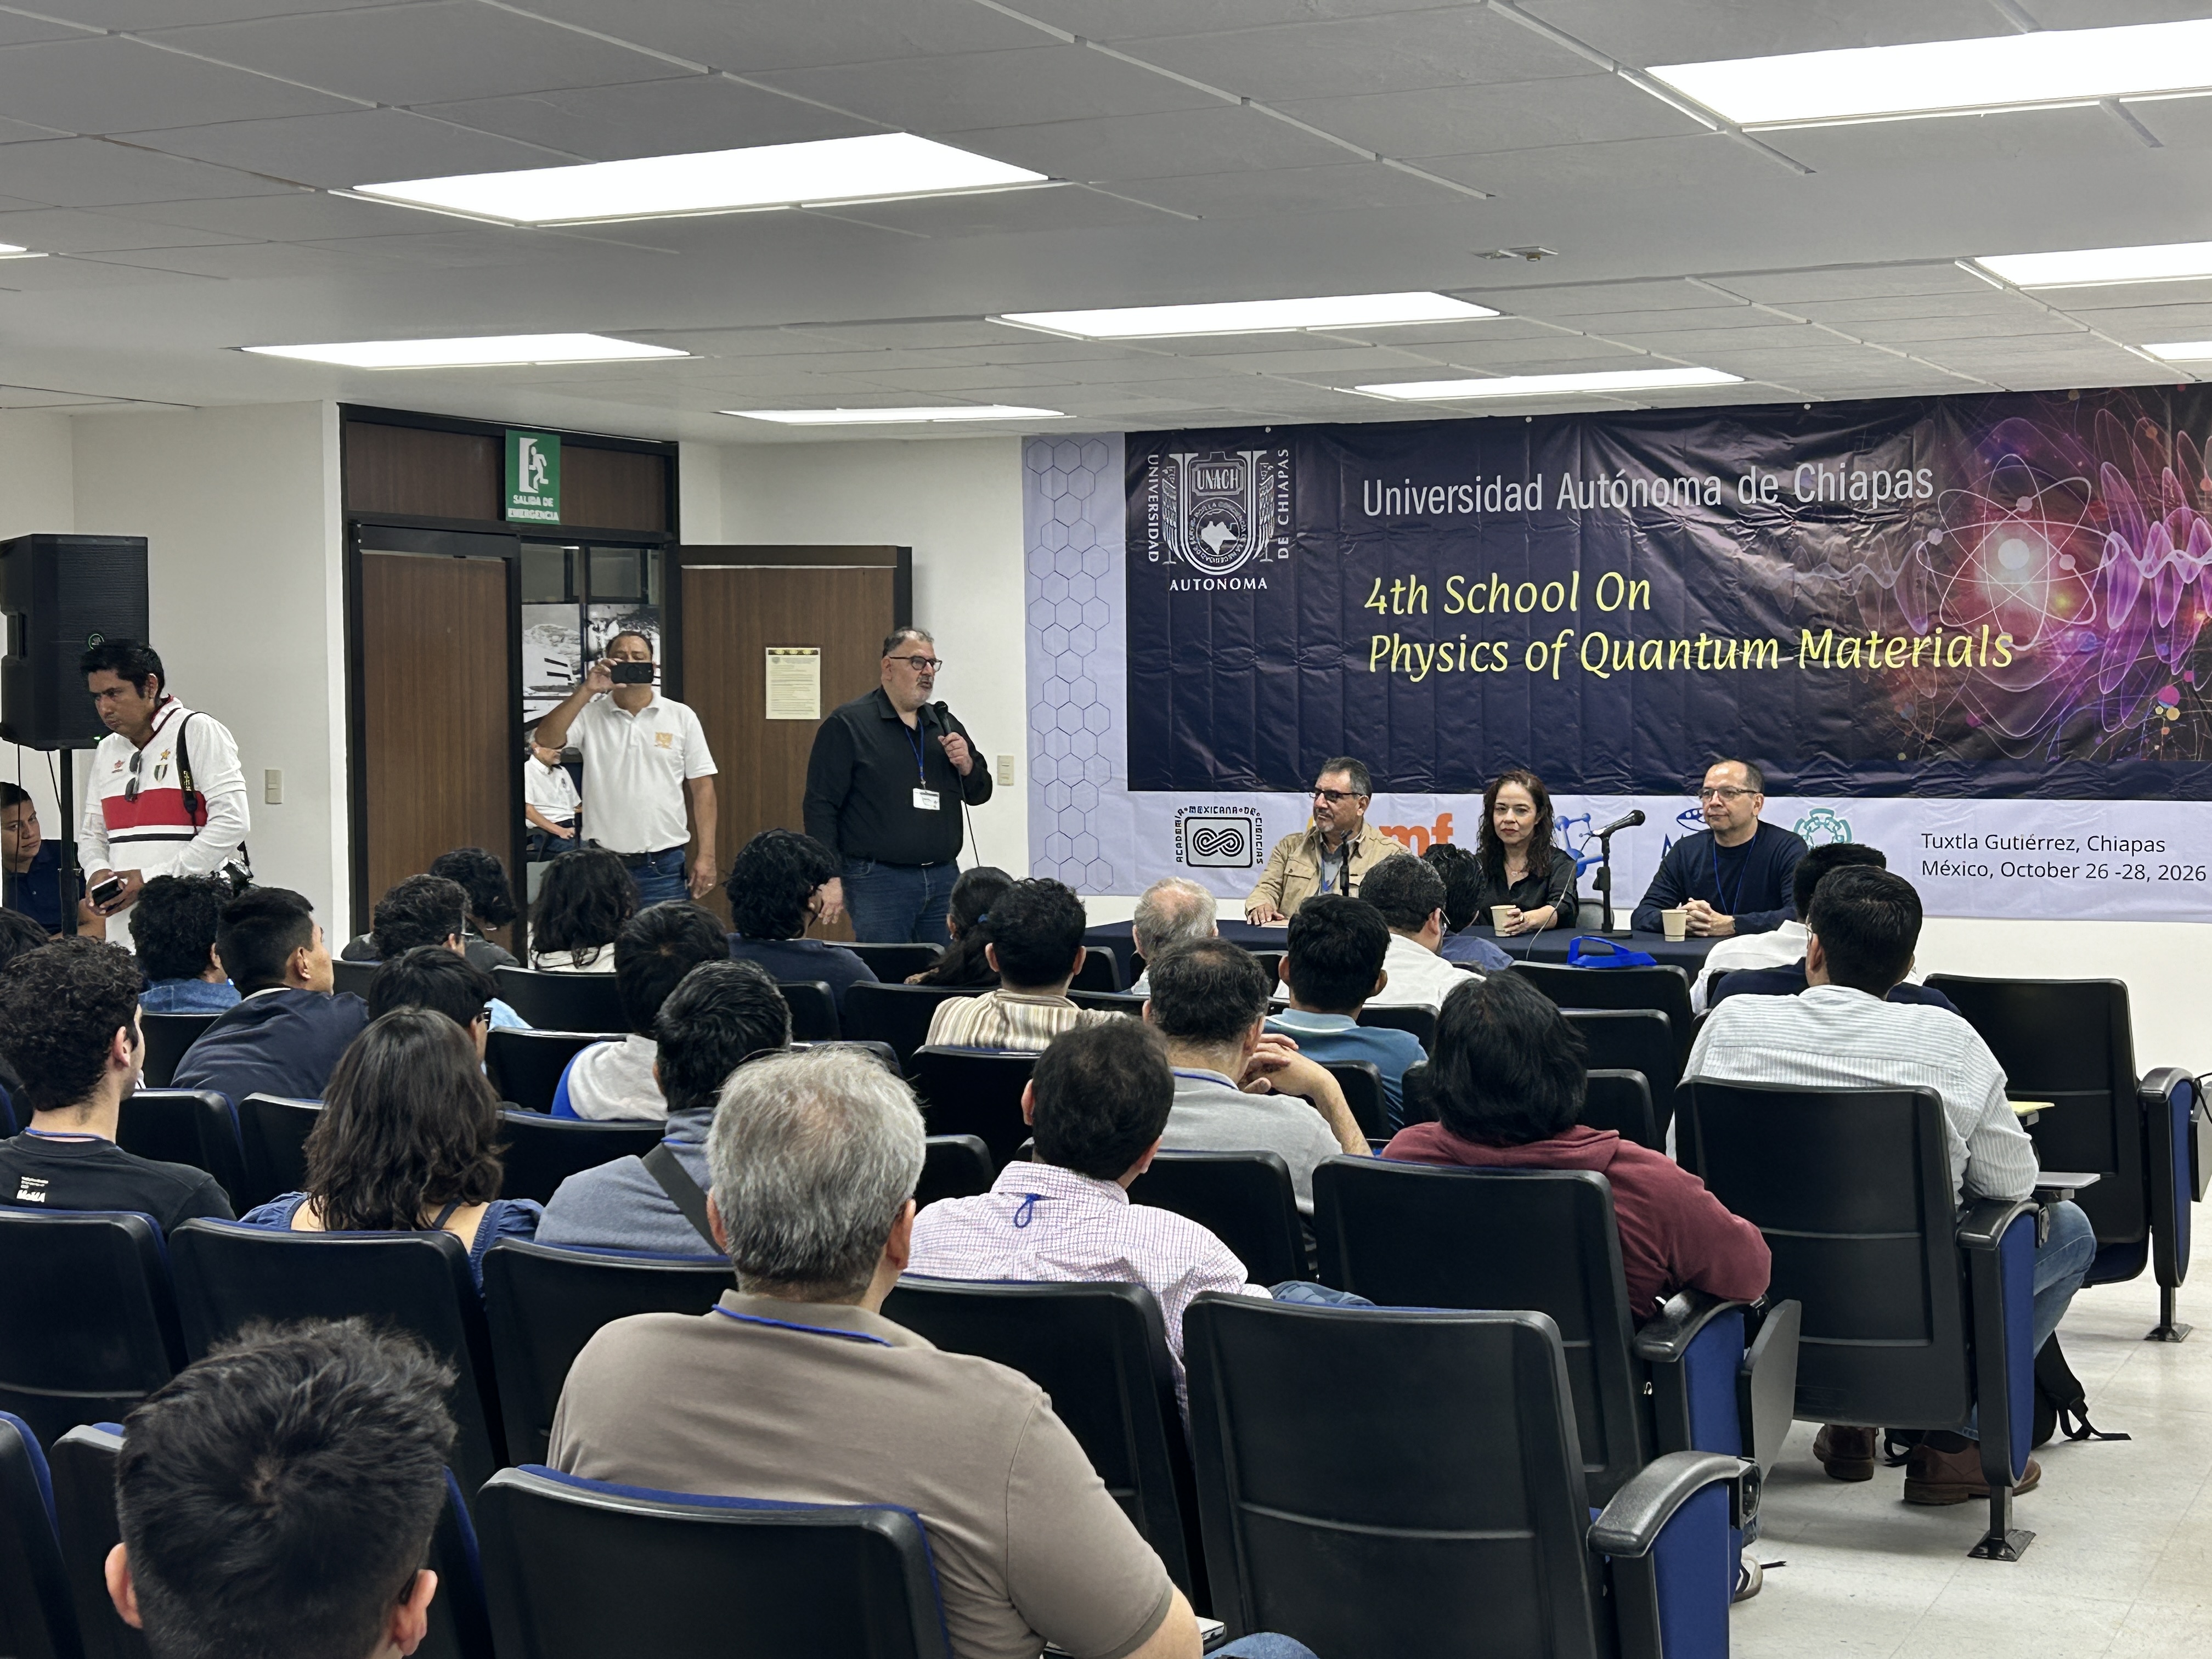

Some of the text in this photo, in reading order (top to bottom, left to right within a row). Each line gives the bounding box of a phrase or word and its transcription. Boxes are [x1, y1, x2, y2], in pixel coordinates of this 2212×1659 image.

[1197, 469, 1239, 490] UNACH
[1364, 462, 1933, 516] Universidad Autónoma de Chiapas
[1147, 454, 1159, 562] UNIVERSIDAD
[1277, 449, 1289, 559] DE CHIAPAS
[1169, 578, 1268, 591] AUTONOMA
[1364, 570, 1651, 615] 4th School On
[1369, 624, 2014, 682] Physics of Quantum Materials
[1921, 833, 2166, 857] Tuxtla Gutiérrez, Chiapas
[1922, 860, 2206, 883] México, October 26 -28, 2026
